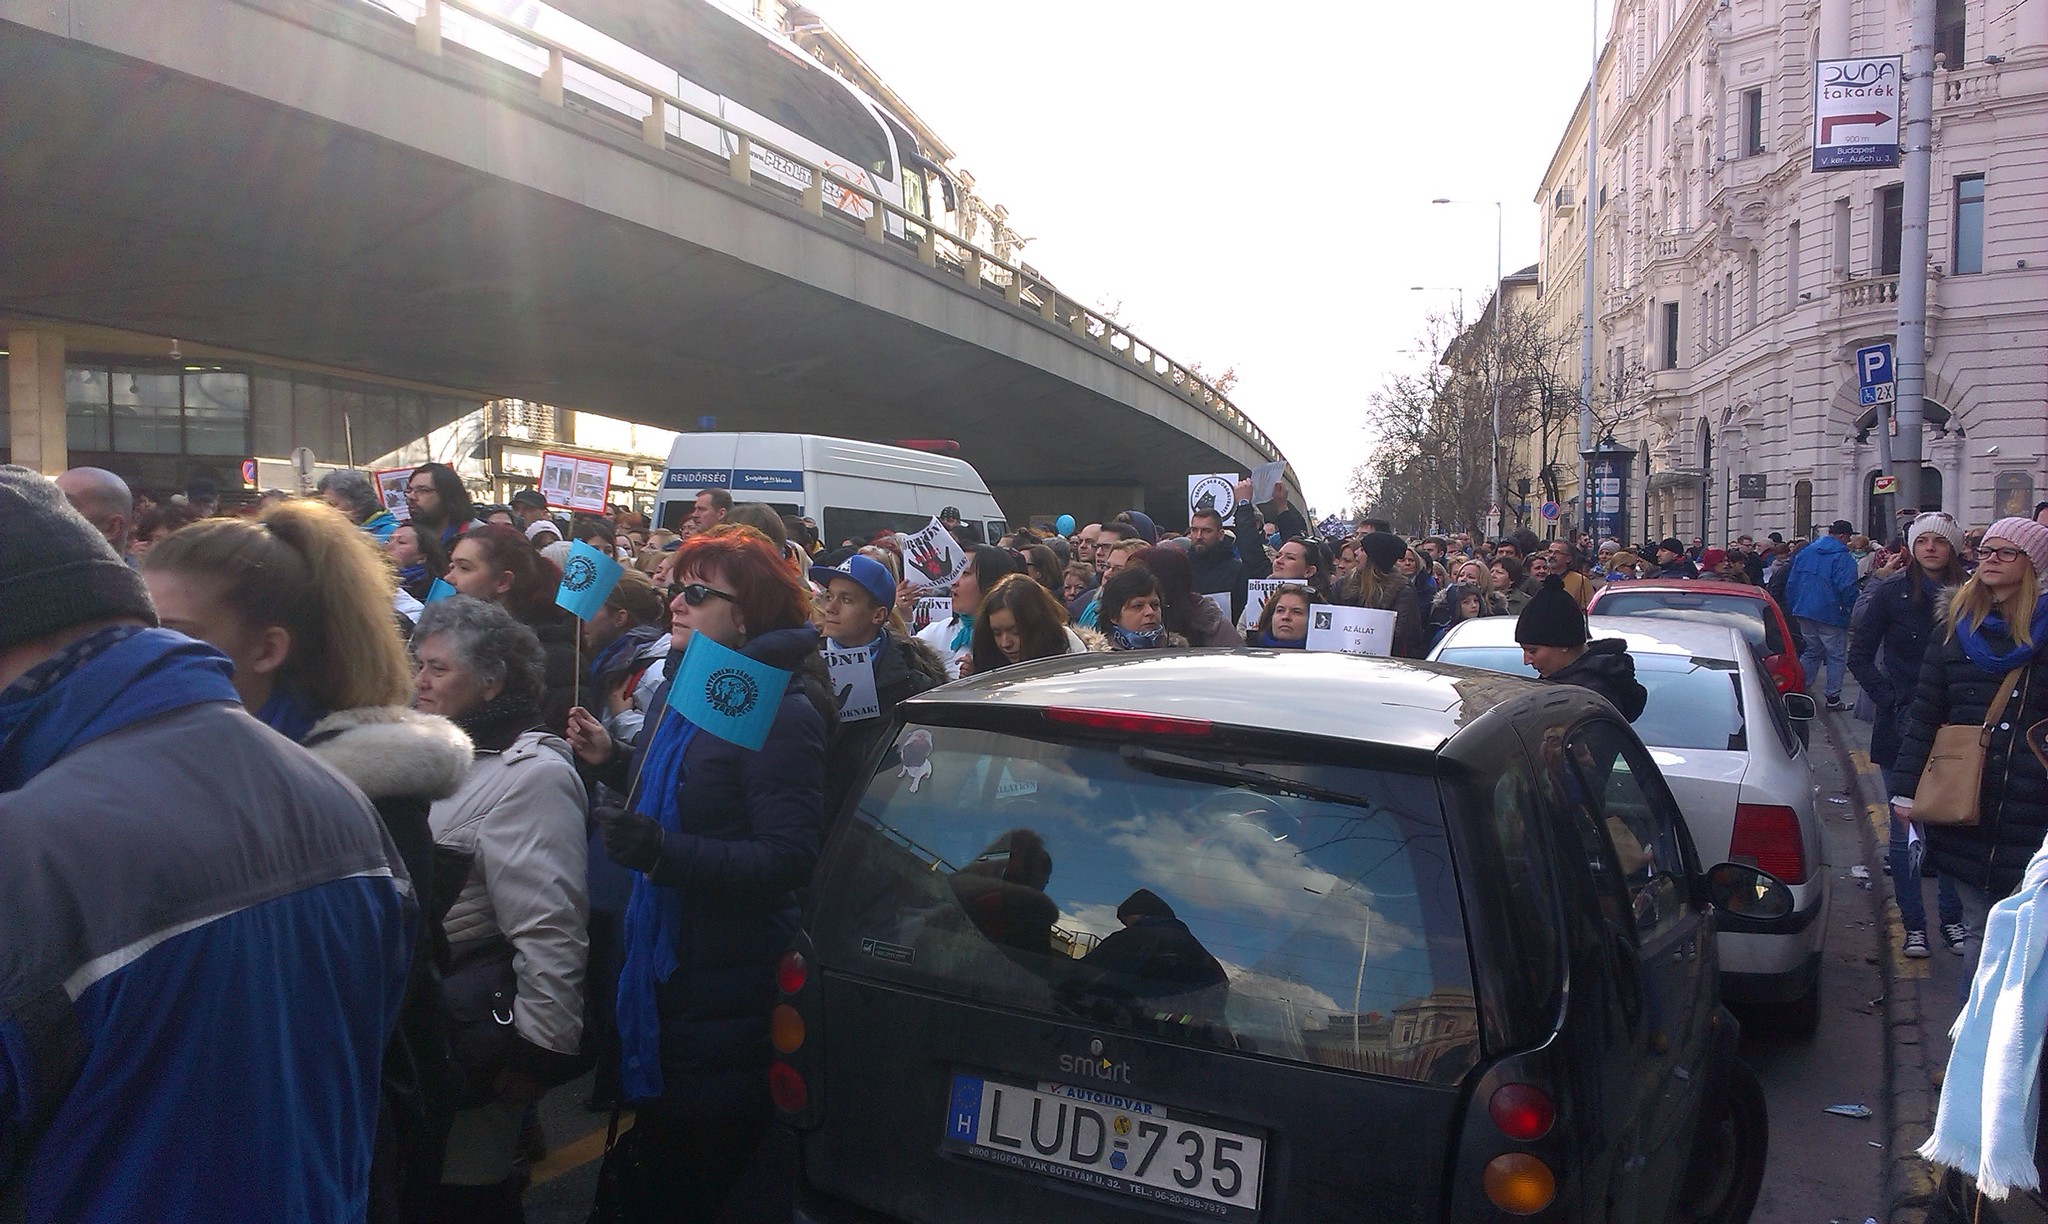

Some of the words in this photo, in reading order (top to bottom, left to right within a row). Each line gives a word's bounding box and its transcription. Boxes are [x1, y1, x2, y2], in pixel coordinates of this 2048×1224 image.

[1824, 85, 1894, 99] takarék
[1837, 146, 1875, 156] Budapest
[1850, 155, 1875, 163] Aulich
[1864, 351, 1885, 382] P
[670, 472, 727, 483] RENDŐRSÉG
[1353, 625, 1375, 635] ÁLLAT
[1060, 1054, 1131, 1084] smart
[958, 1114, 971, 1134] H
[1107, 1179, 1121, 1189] 32.
